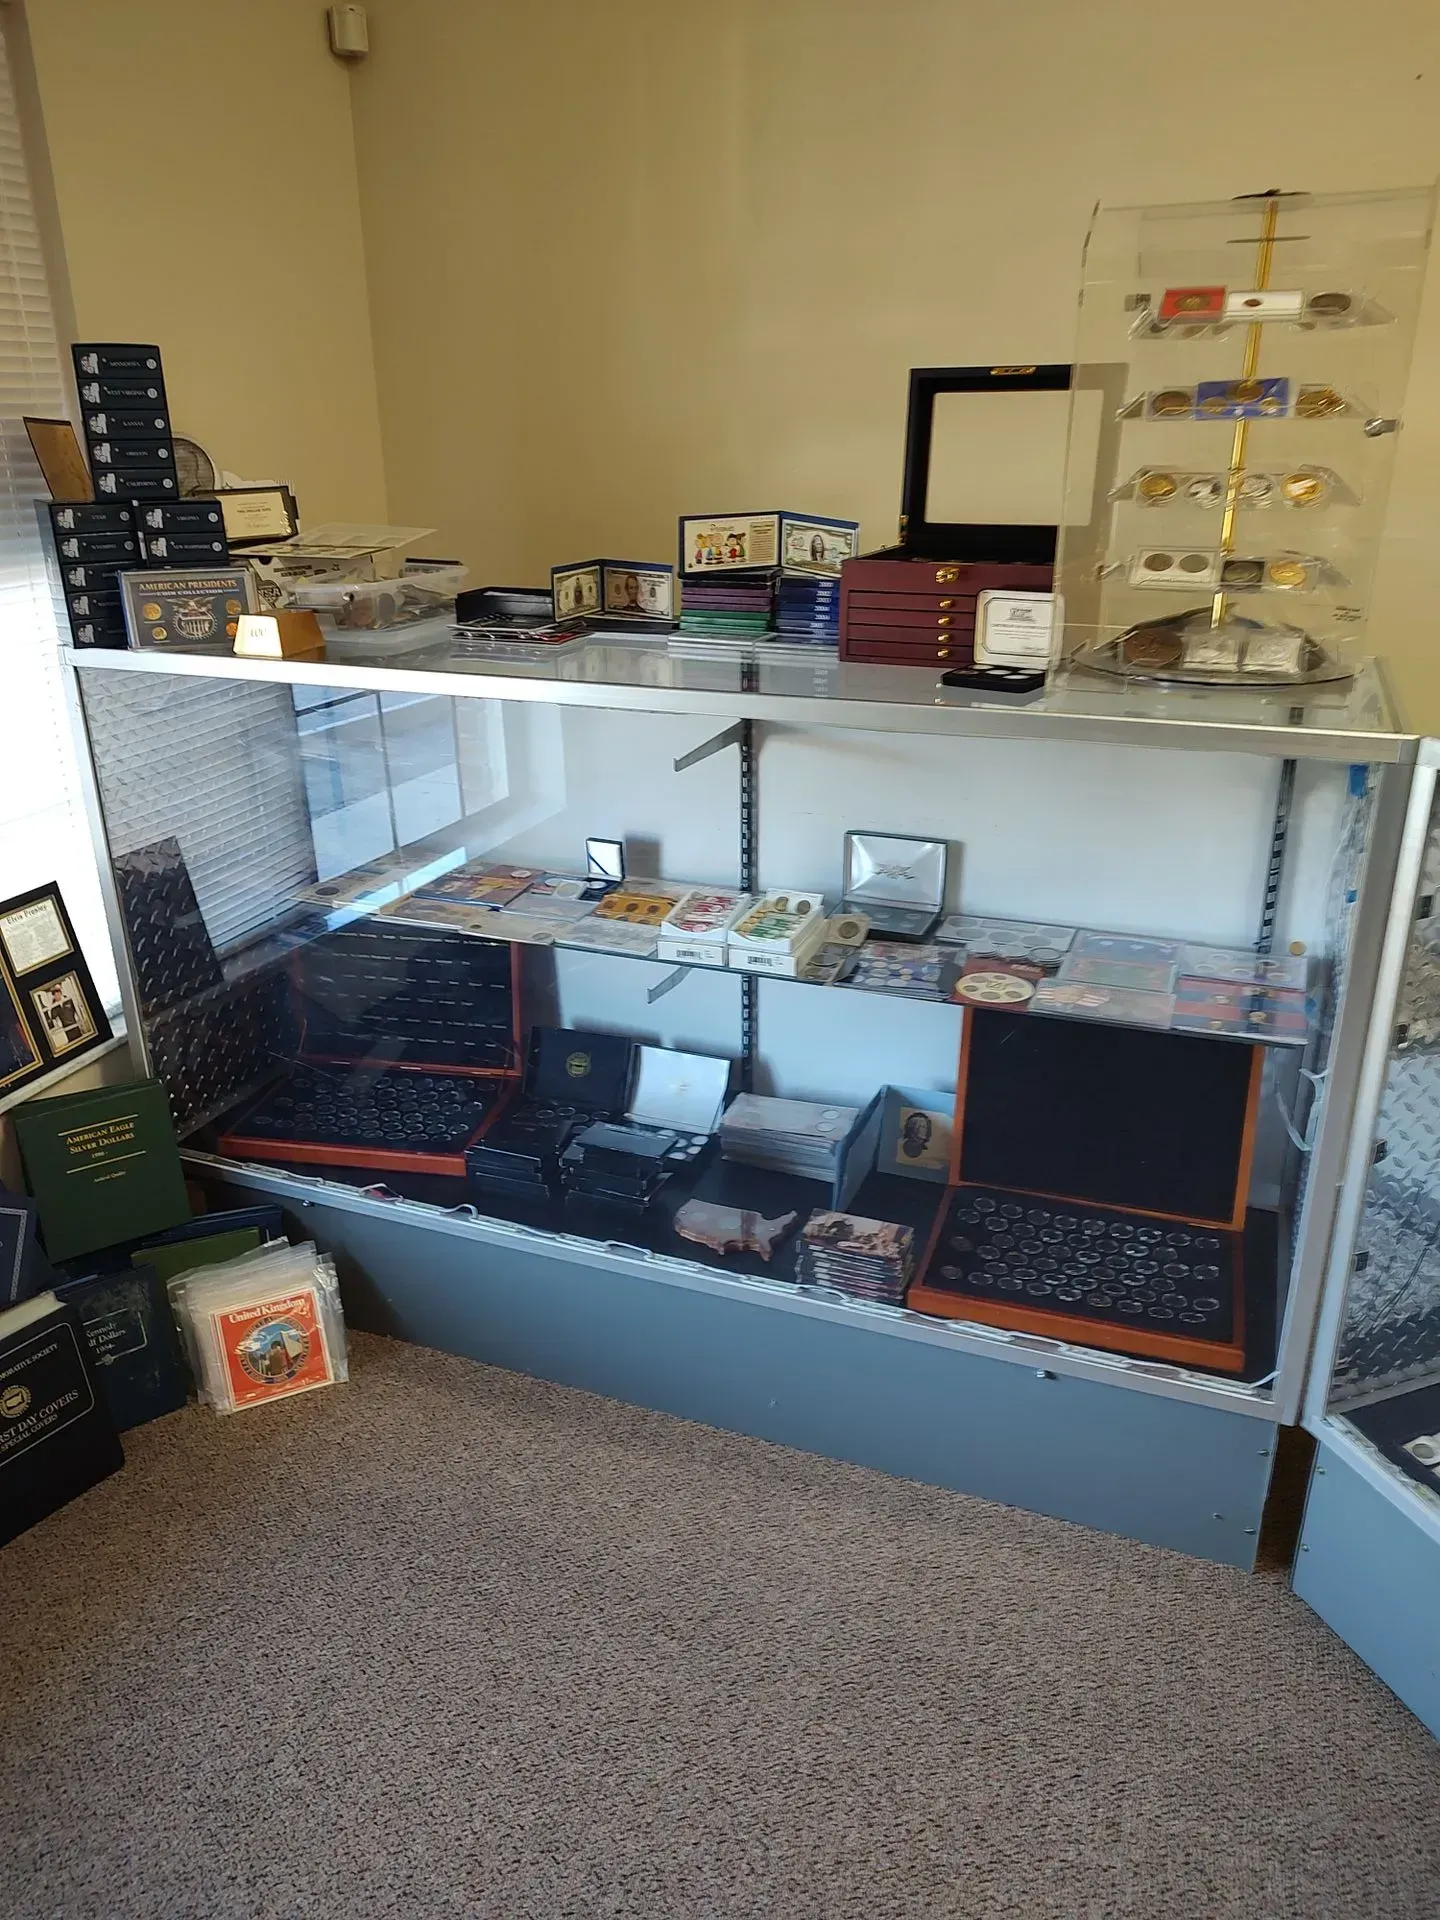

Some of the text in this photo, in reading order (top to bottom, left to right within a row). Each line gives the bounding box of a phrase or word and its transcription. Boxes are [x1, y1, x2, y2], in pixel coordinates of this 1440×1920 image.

[139, 579, 238, 591] AMERICAN PRESIDENTS
[6, 904, 47, 925] Elvis Presley
[66, 1122, 135, 1145] AMERICAN EAGLE
[69, 1132, 135, 1155] SILVER DOLLARS
[228, 1298, 306, 1324] United Kingdom
[31, 1342, 58, 1361] SOCIETY
[18, 1412, 38, 1431] DAY
[39, 1389, 79, 1418] COVERS
[0, 1413, 58, 1452] SPECIAL COVERS
